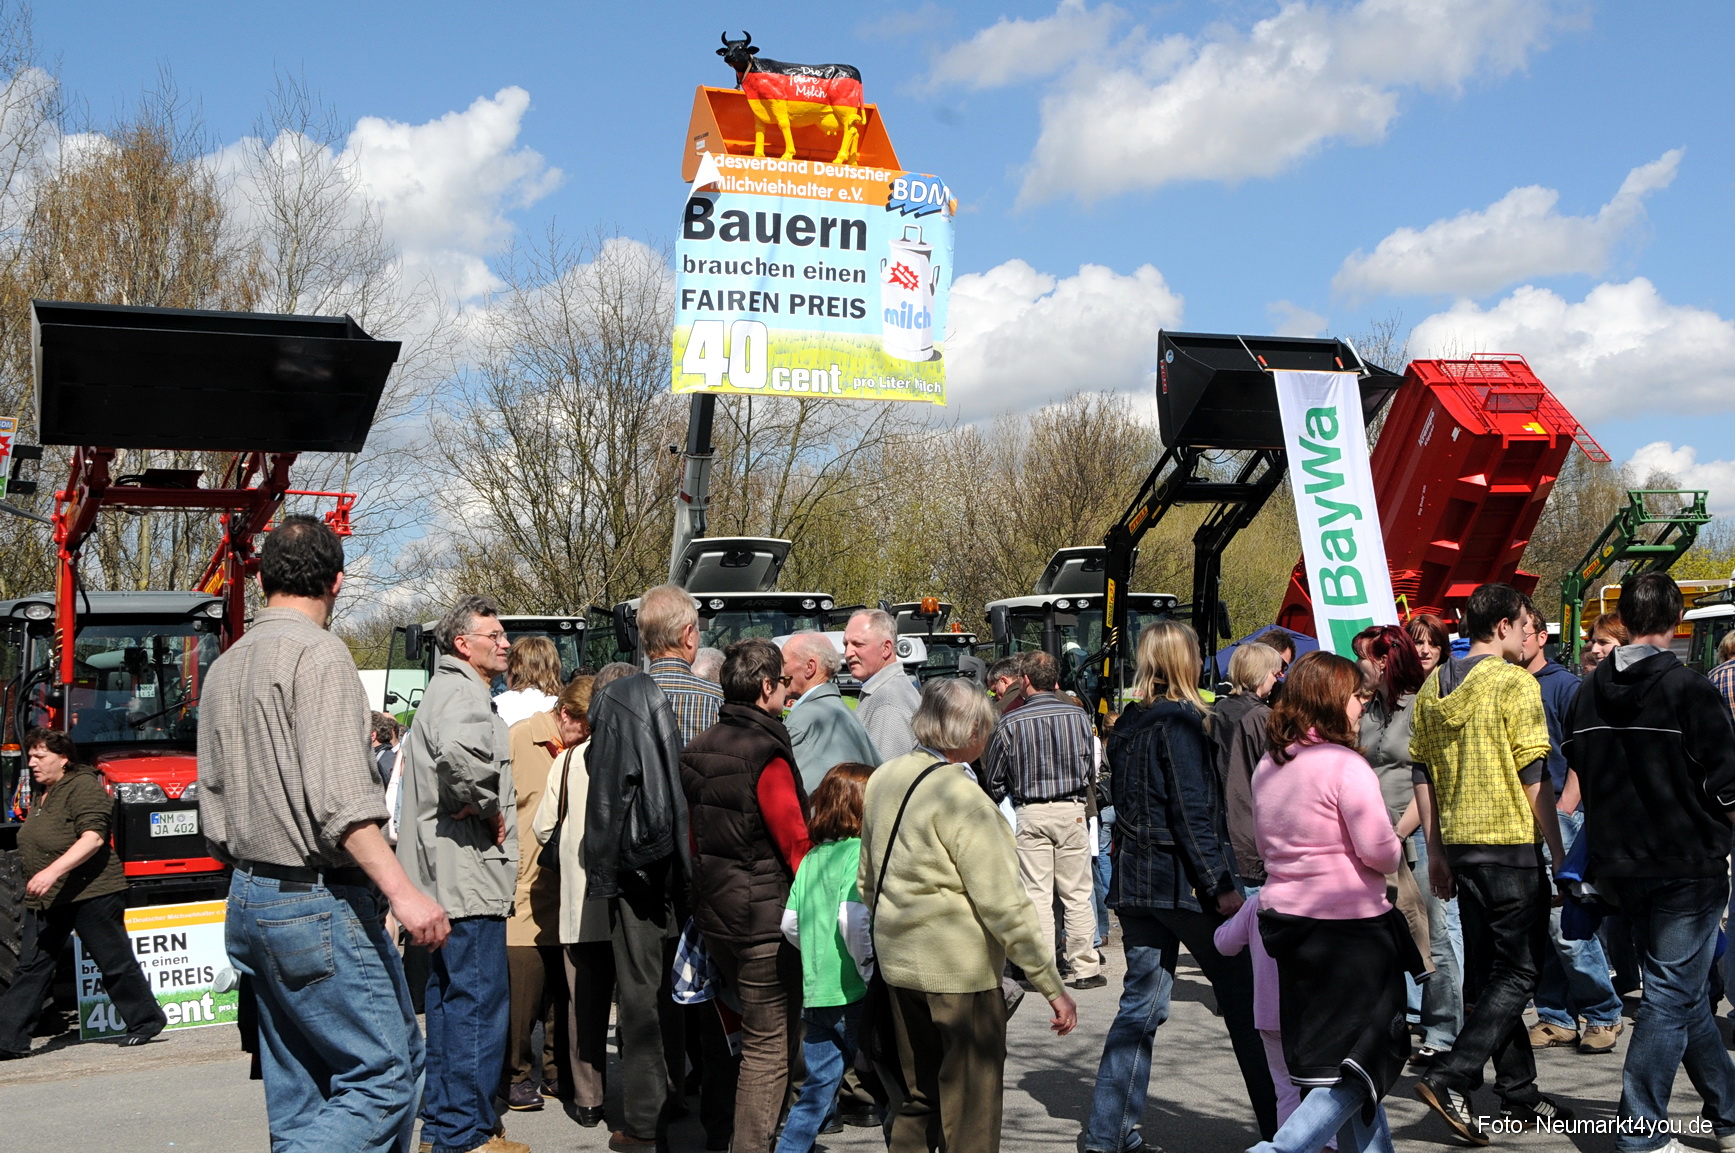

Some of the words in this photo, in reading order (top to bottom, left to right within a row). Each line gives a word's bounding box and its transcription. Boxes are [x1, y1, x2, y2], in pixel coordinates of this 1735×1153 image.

[800, 66, 823, 76] Die
[796, 85, 827, 98] Milch
[714, 154, 807, 174] desverband
[814, 161, 890, 182] Deutscher
[838, 187, 863, 201] e.V.
[893, 178, 950, 206] BDM
[682, 196, 867, 251] Bauern
[683, 254, 795, 279] brauchen
[803, 261, 866, 283] einen
[681, 289, 779, 314] FAIREN
[789, 294, 866, 319] PREIS
[884, 301, 932, 329] milch
[682, 320, 768, 389] 40
[772, 364, 842, 394] cent
[853, 377, 876, 389] pro
[879, 376, 911, 389] Liter
[1299, 405, 1369, 606] BayWa
[1584, 559, 1599, 577] STOLL
[741, 599, 784, 607] ARES
[155, 825, 168, 835] JA
[174, 823, 194, 833] 402
[160, 814, 174, 824] NM
[133, 916, 166, 924] Deutscher
[152, 956, 188, 967] einen
[160, 966, 214, 988] PREIS
[162, 992, 215, 1025] ent
[219, 1004, 231, 1013] pro
